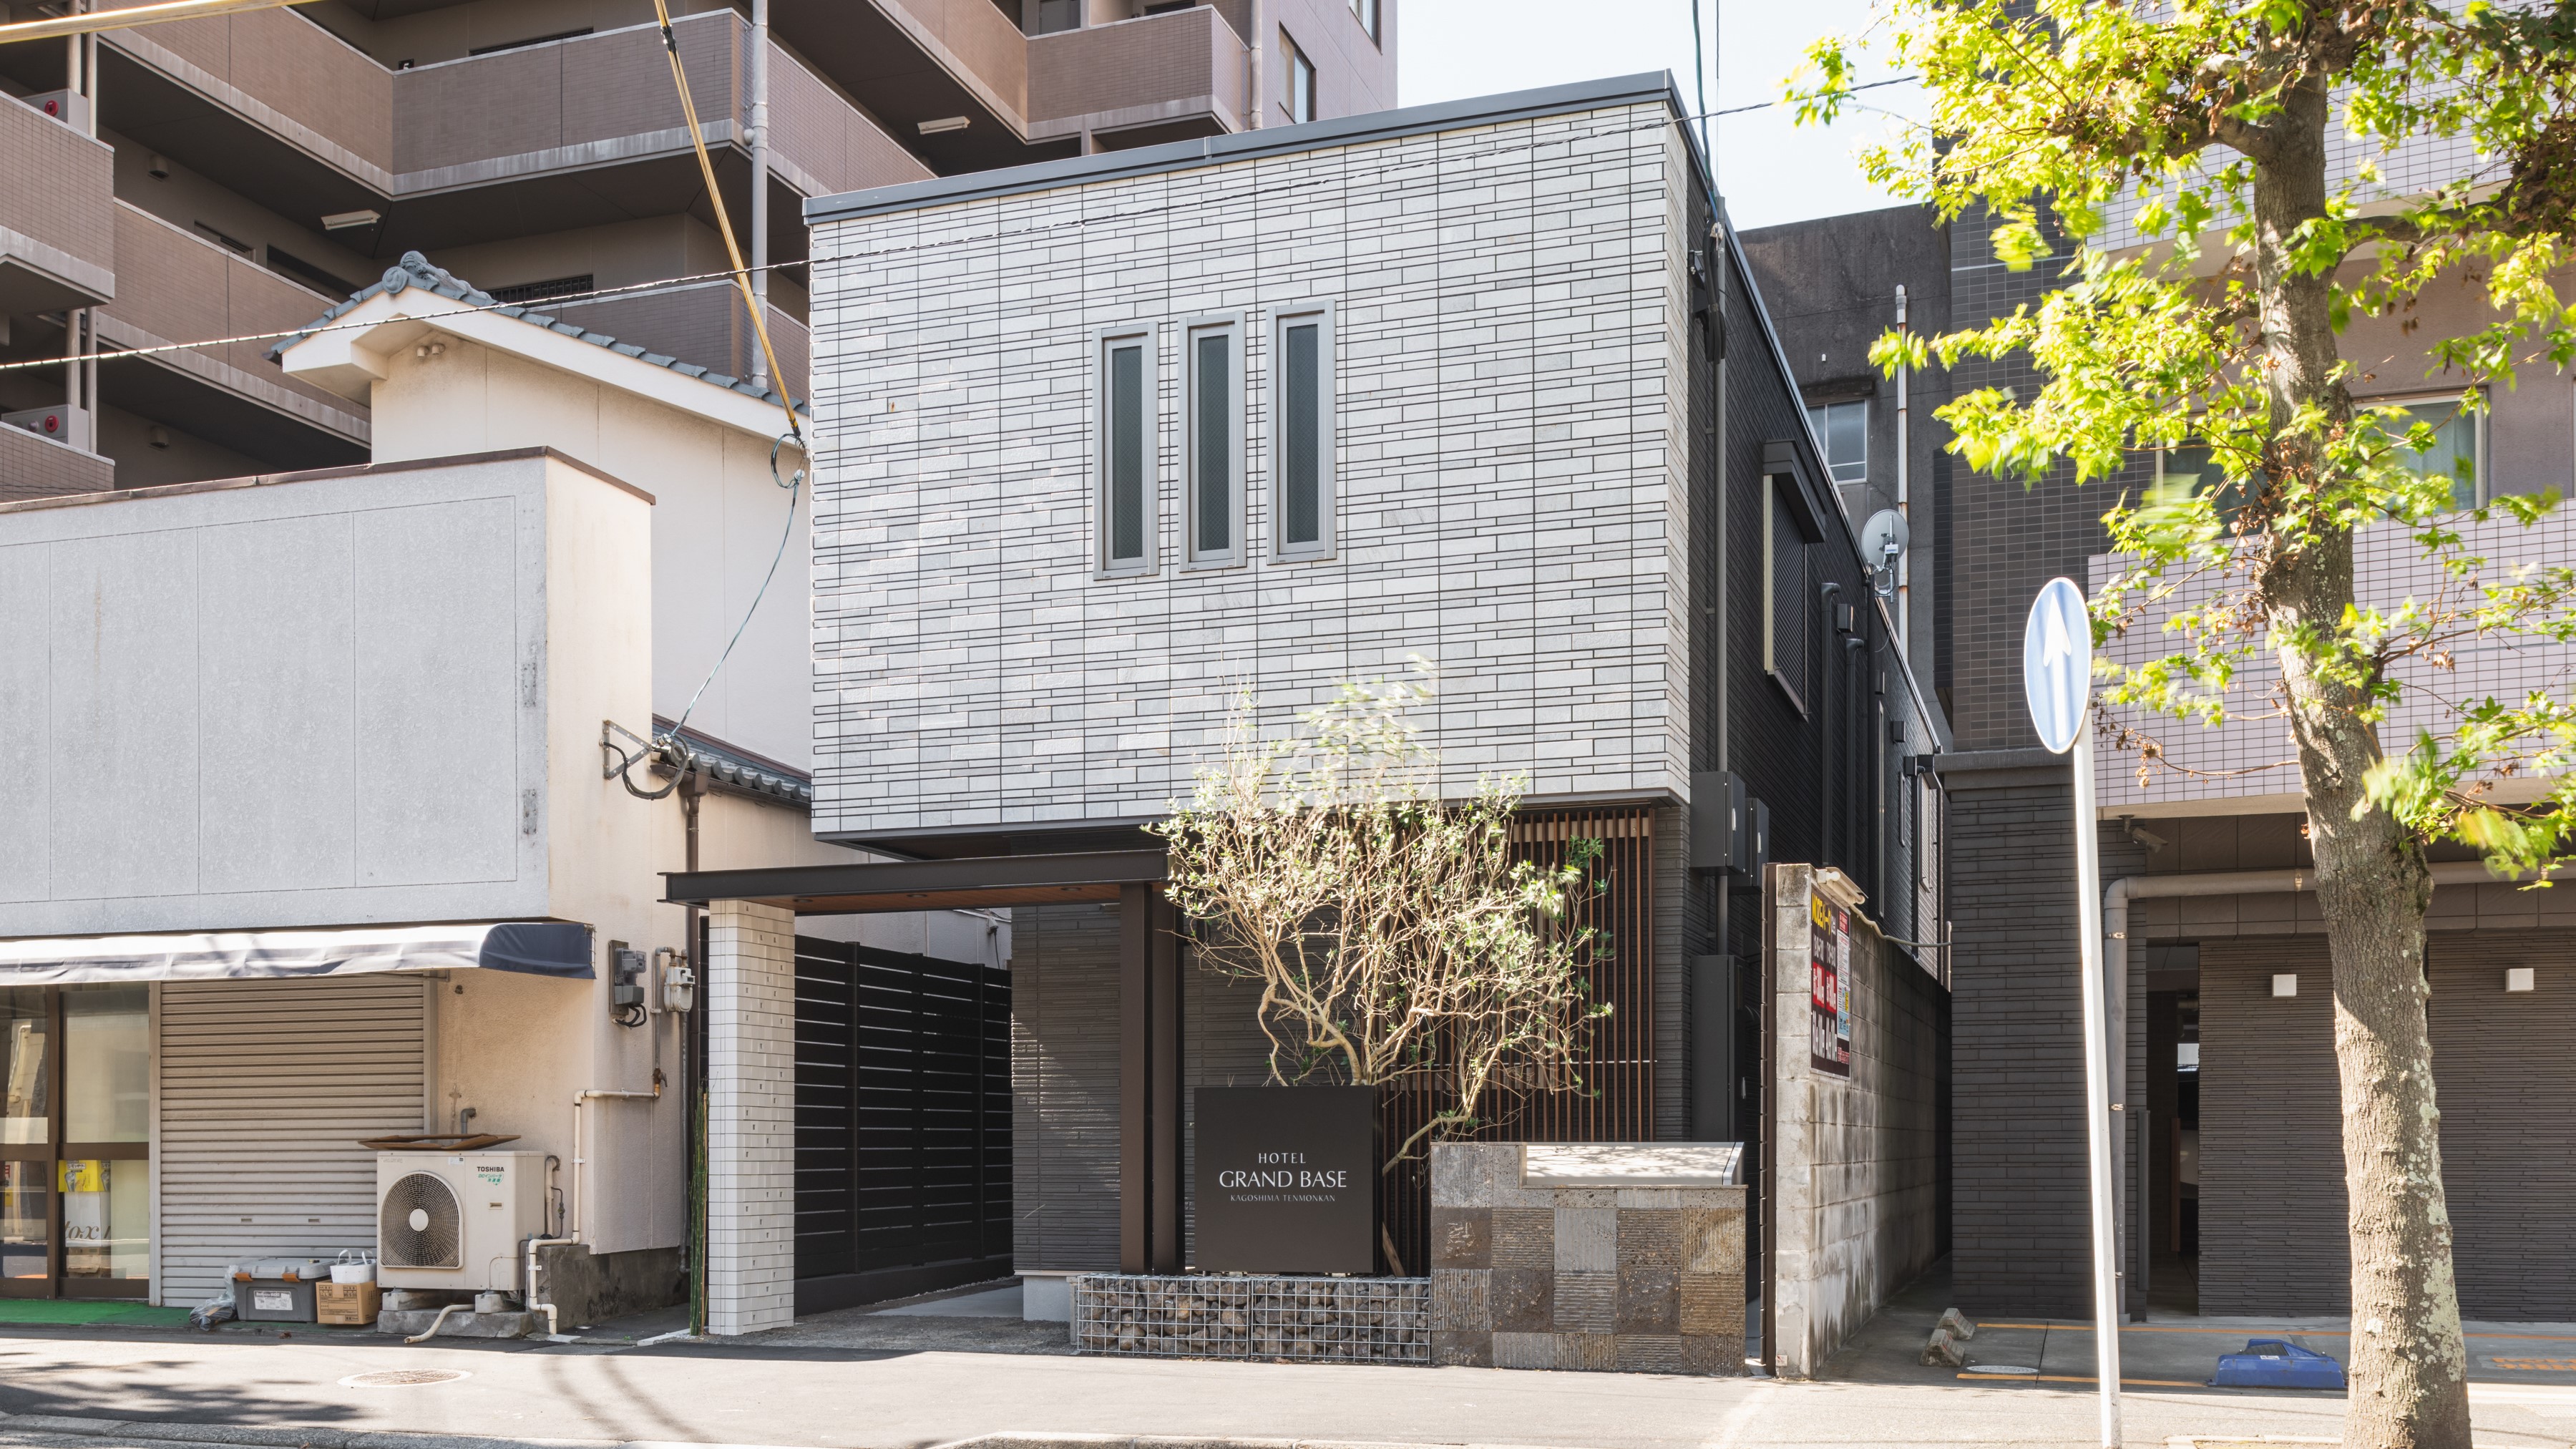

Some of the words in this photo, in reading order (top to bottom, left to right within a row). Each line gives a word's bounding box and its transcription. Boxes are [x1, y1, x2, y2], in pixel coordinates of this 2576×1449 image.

[1259, 1153, 1306, 1163] HOTEL
[1219, 1171, 1292, 1188] GRAND
[1300, 1171, 1347, 1188] BASE
